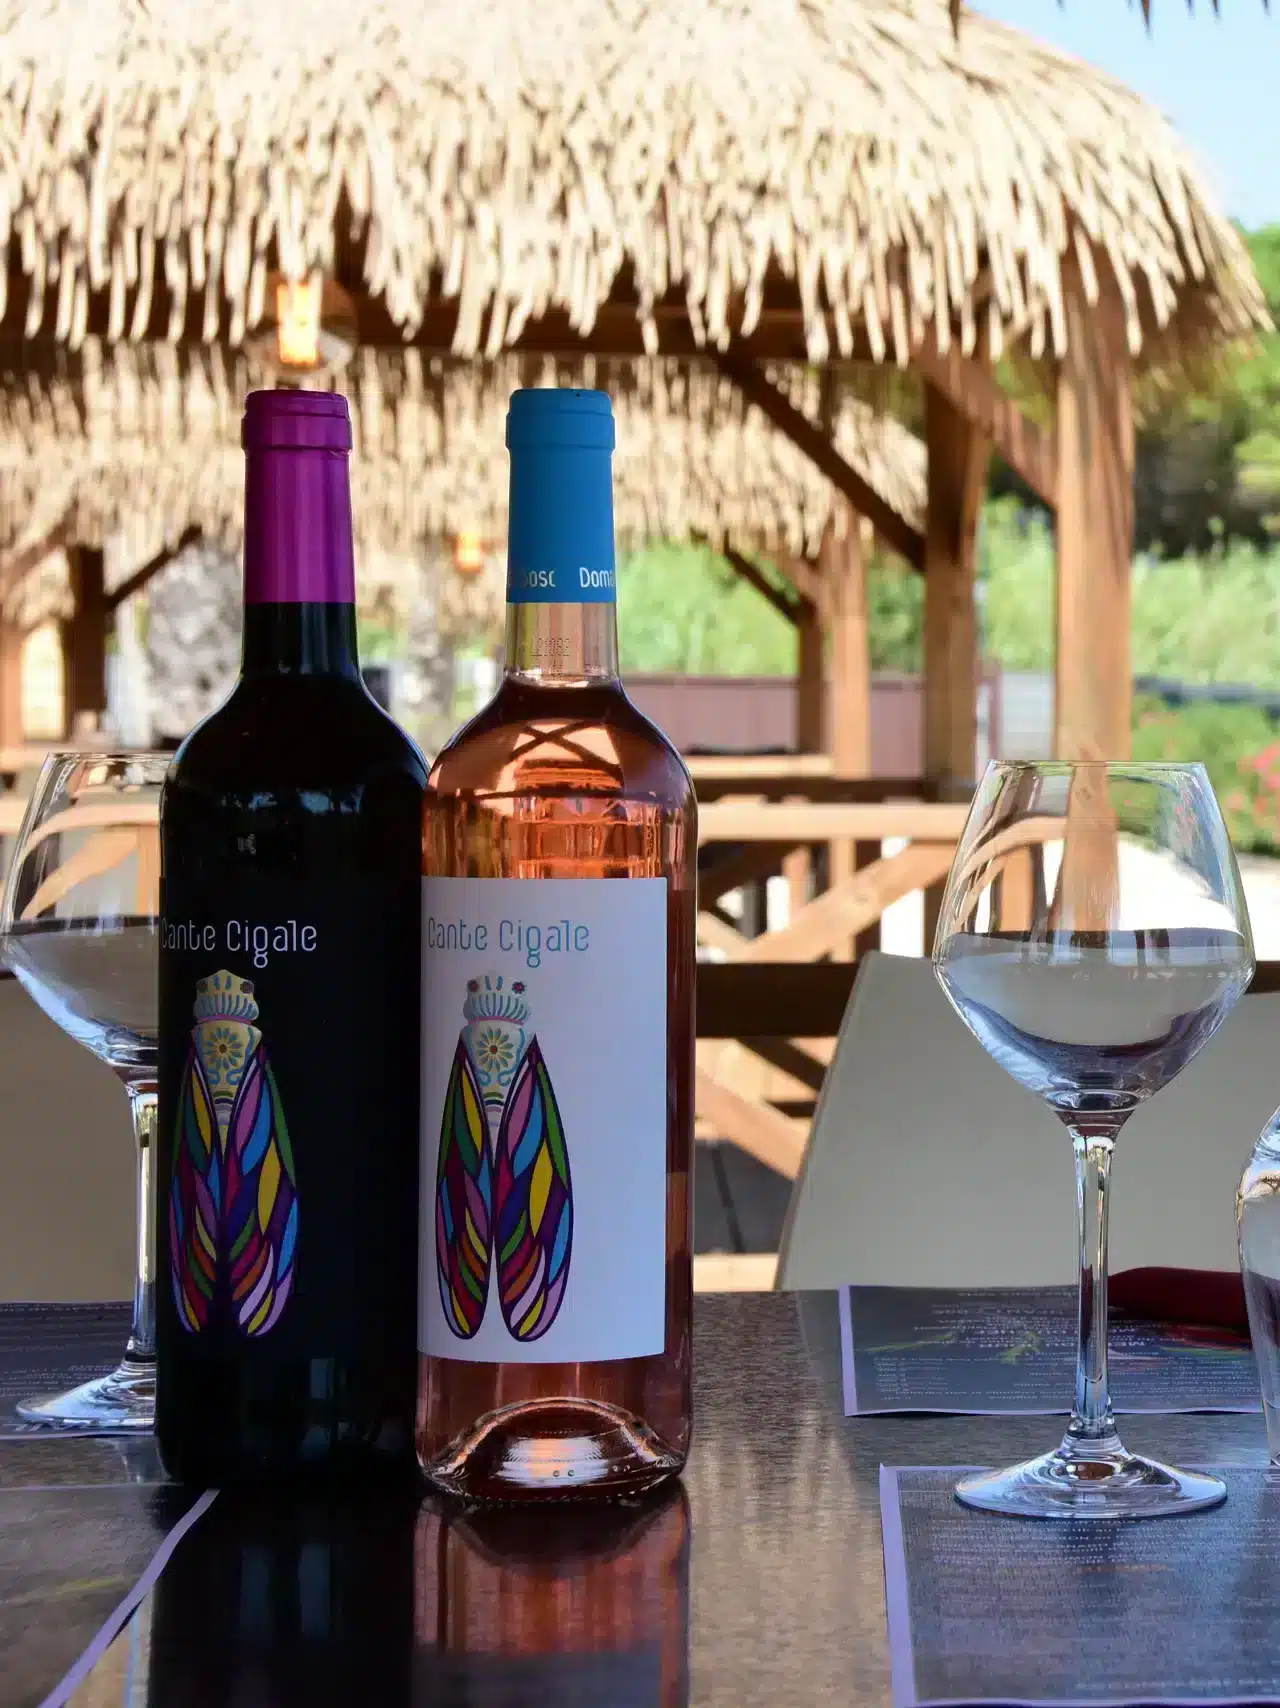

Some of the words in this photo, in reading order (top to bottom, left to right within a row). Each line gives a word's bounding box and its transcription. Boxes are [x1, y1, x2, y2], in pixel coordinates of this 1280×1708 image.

[161, 918, 216, 951] Cante
[226, 919, 318, 969] Cigale
[427, 916, 488, 951] Cante
[499, 918, 590, 969] Cigale
